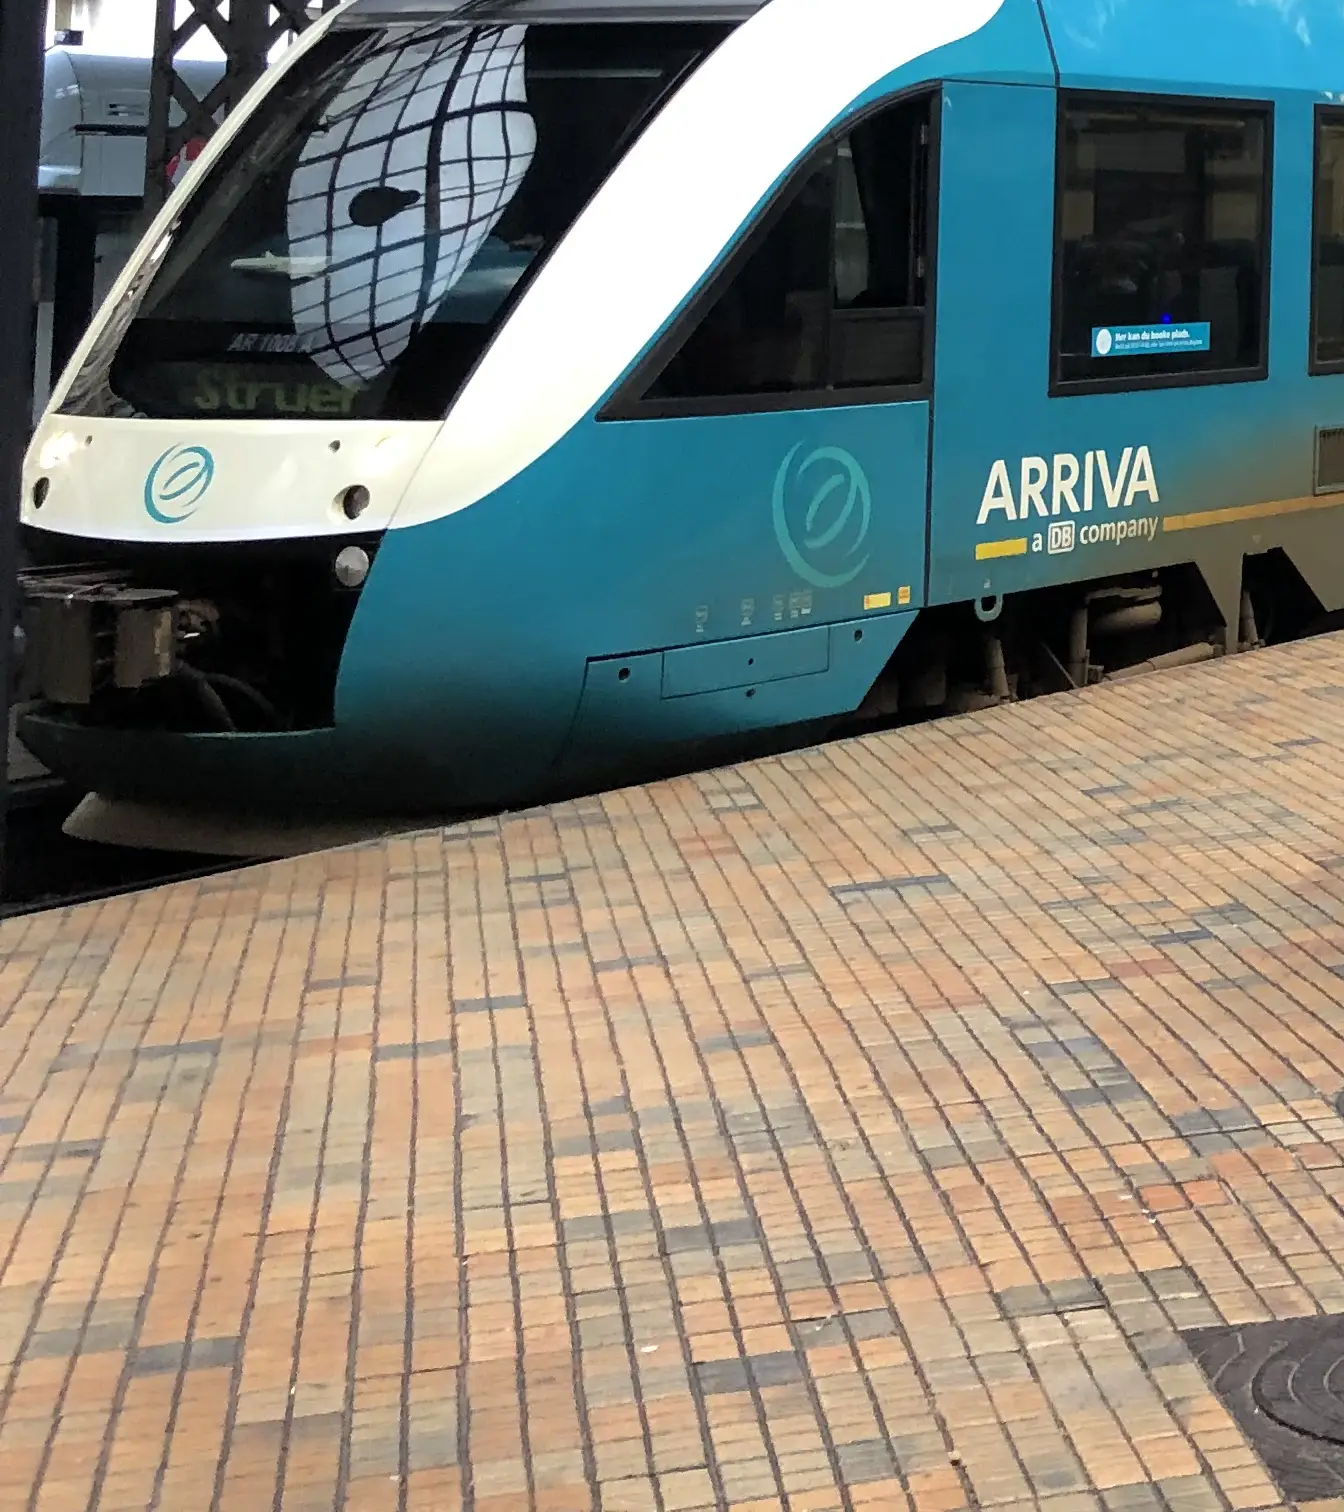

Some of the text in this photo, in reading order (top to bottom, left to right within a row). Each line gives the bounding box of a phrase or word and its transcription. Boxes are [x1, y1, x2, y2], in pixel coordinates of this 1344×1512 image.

[194, 368, 358, 414] Struer
[976, 445, 1160, 525] ARRIVA
[1031, 516, 1159, 553] a DB company
